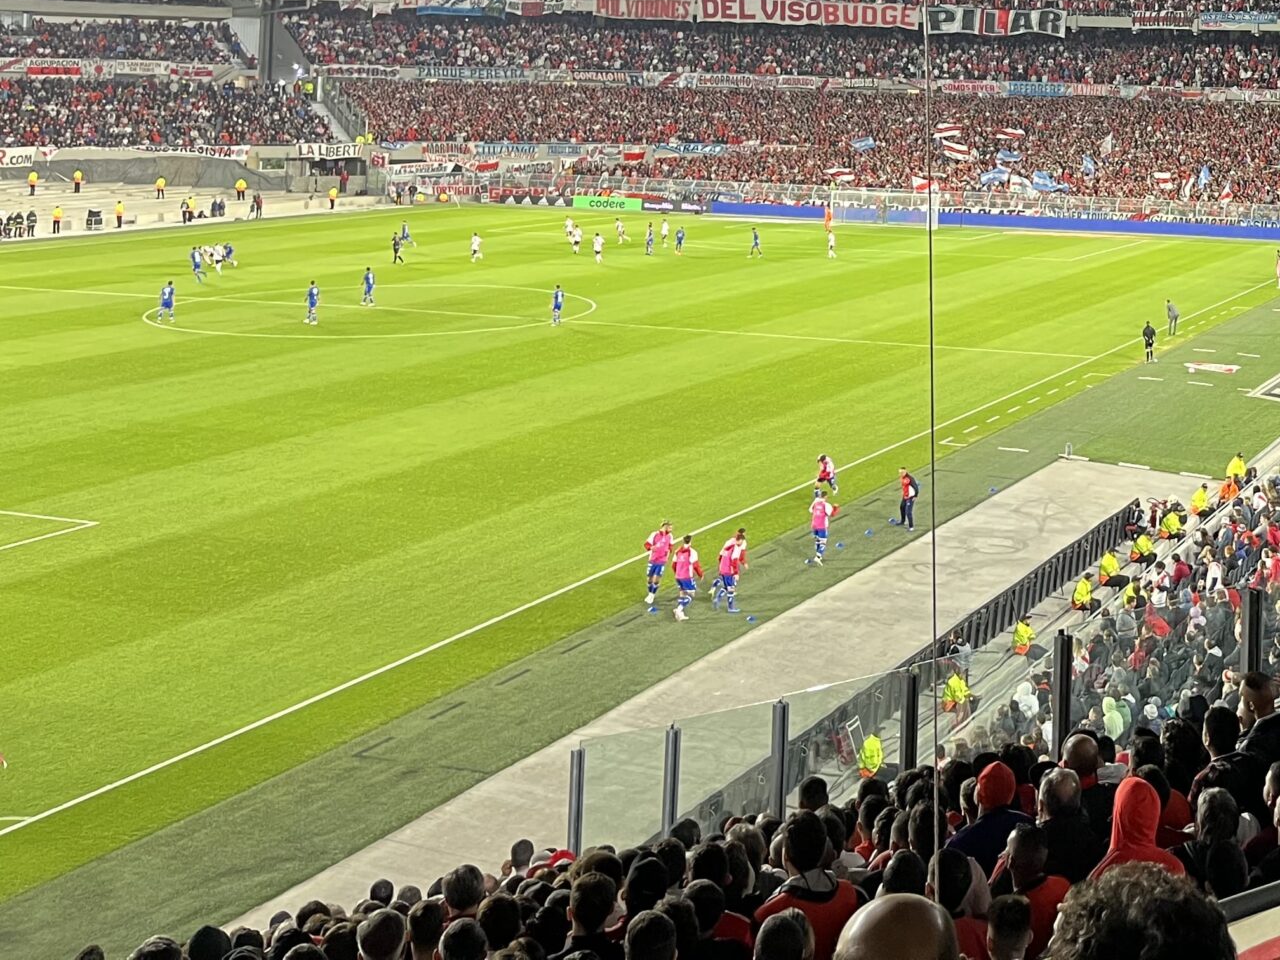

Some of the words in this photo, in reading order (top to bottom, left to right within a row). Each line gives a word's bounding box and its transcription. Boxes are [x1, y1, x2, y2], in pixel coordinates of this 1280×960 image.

[760, 0, 823, 22] VISO
[824, 3, 918, 27] BUDGE
[928, 7, 1064, 34] PILAR
[588, 200, 627, 210] codere
